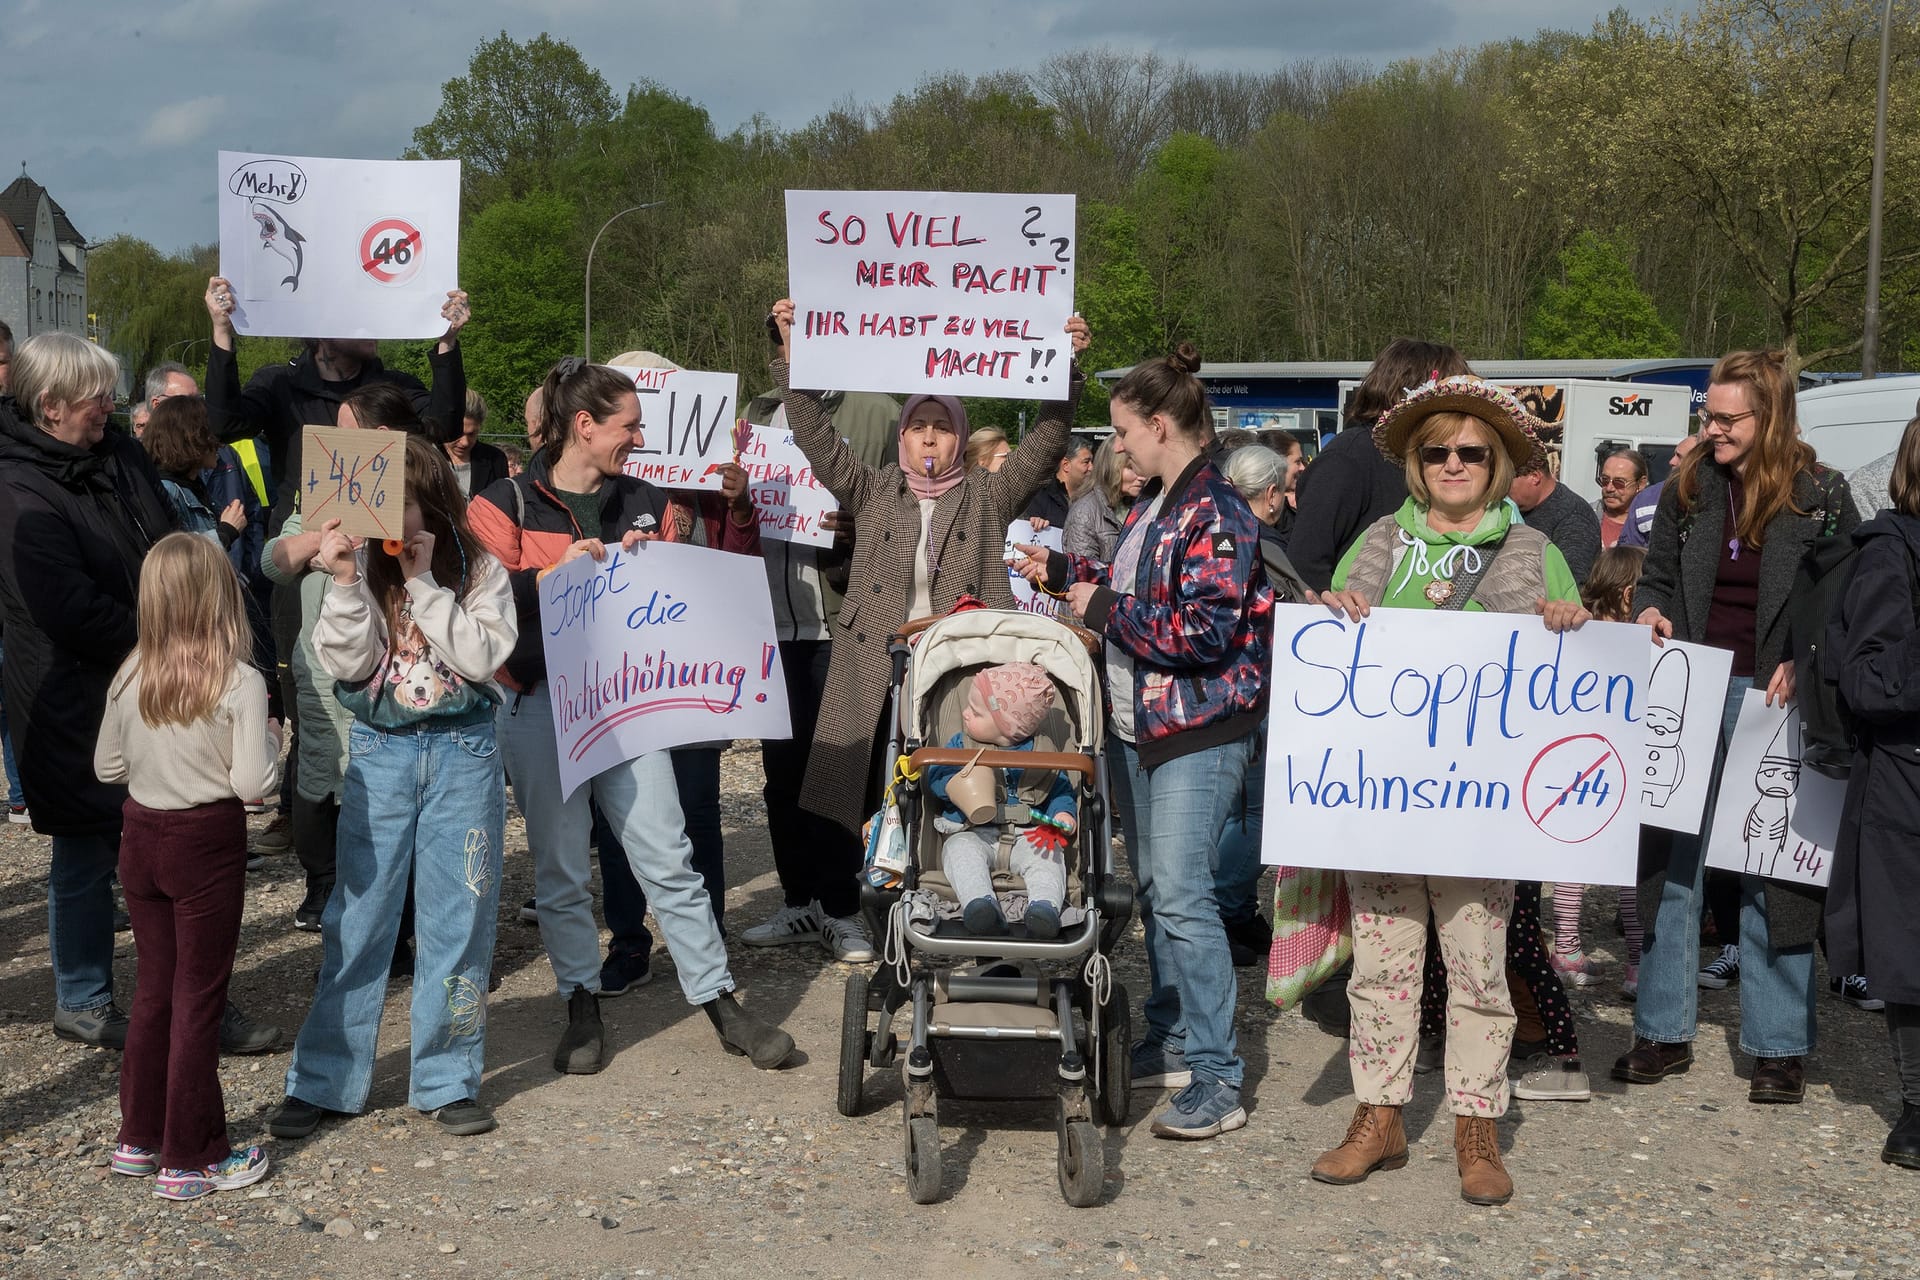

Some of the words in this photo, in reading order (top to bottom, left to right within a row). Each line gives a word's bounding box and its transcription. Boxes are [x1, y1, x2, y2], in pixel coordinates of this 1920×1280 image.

[236, 171, 301, 201] Mehr!
[815, 210, 867, 246] SO
[886, 211, 987, 248] VIEL
[372, 237, 412, 265] 46
[856, 259, 937, 289] MEHR
[952, 262, 1057, 296] PACHT
[805, 310, 850, 339] IHR
[859, 313, 938, 338] HABT
[943, 315, 976, 336] ZU
[982, 318, 1045, 341] VIEL
[634, 369, 678, 389] MIT
[1222, 384, 1232, 394] der
[1233, 384, 1249, 394] Welt
[550, 551, 631, 637] Stoppt
[626, 590, 688, 629] die
[1287, 747, 1510, 812] Wahnsinn
[1792, 841, 1825, 877] 44
